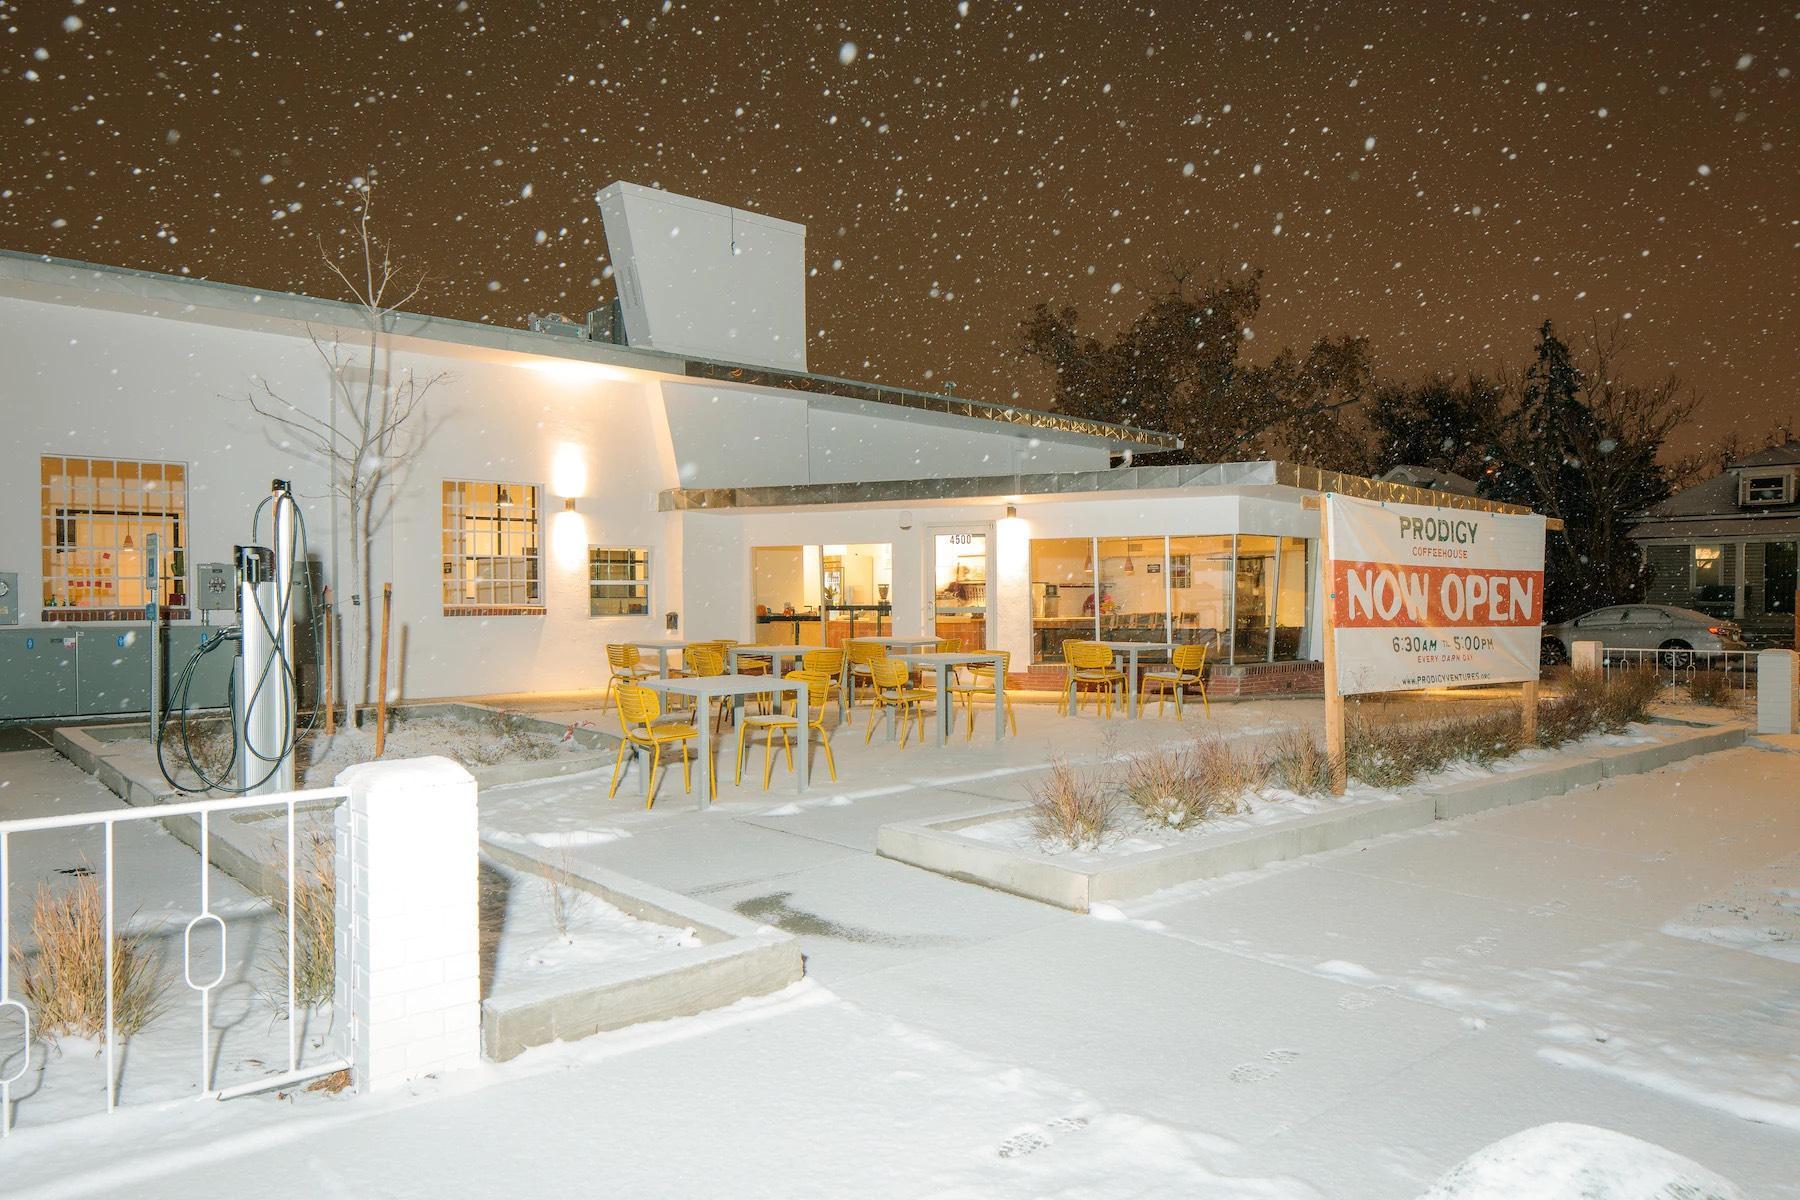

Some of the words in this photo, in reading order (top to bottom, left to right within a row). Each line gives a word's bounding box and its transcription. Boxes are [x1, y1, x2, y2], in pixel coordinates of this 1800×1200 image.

[1400, 515, 1478, 544] PRODIGY
[949, 534, 971, 544] 4500
[1411, 546, 1468, 559] COFFEEHOUSE
[1347, 569, 1429, 621] NOW
[1440, 573, 1533, 621] OPEN
[1392, 636, 1437, 653] 6:30AM
[1453, 635, 1494, 651] 5:00PM
[1417, 655, 1438, 663] EVERY
[1441, 654, 1460, 662] DARN
